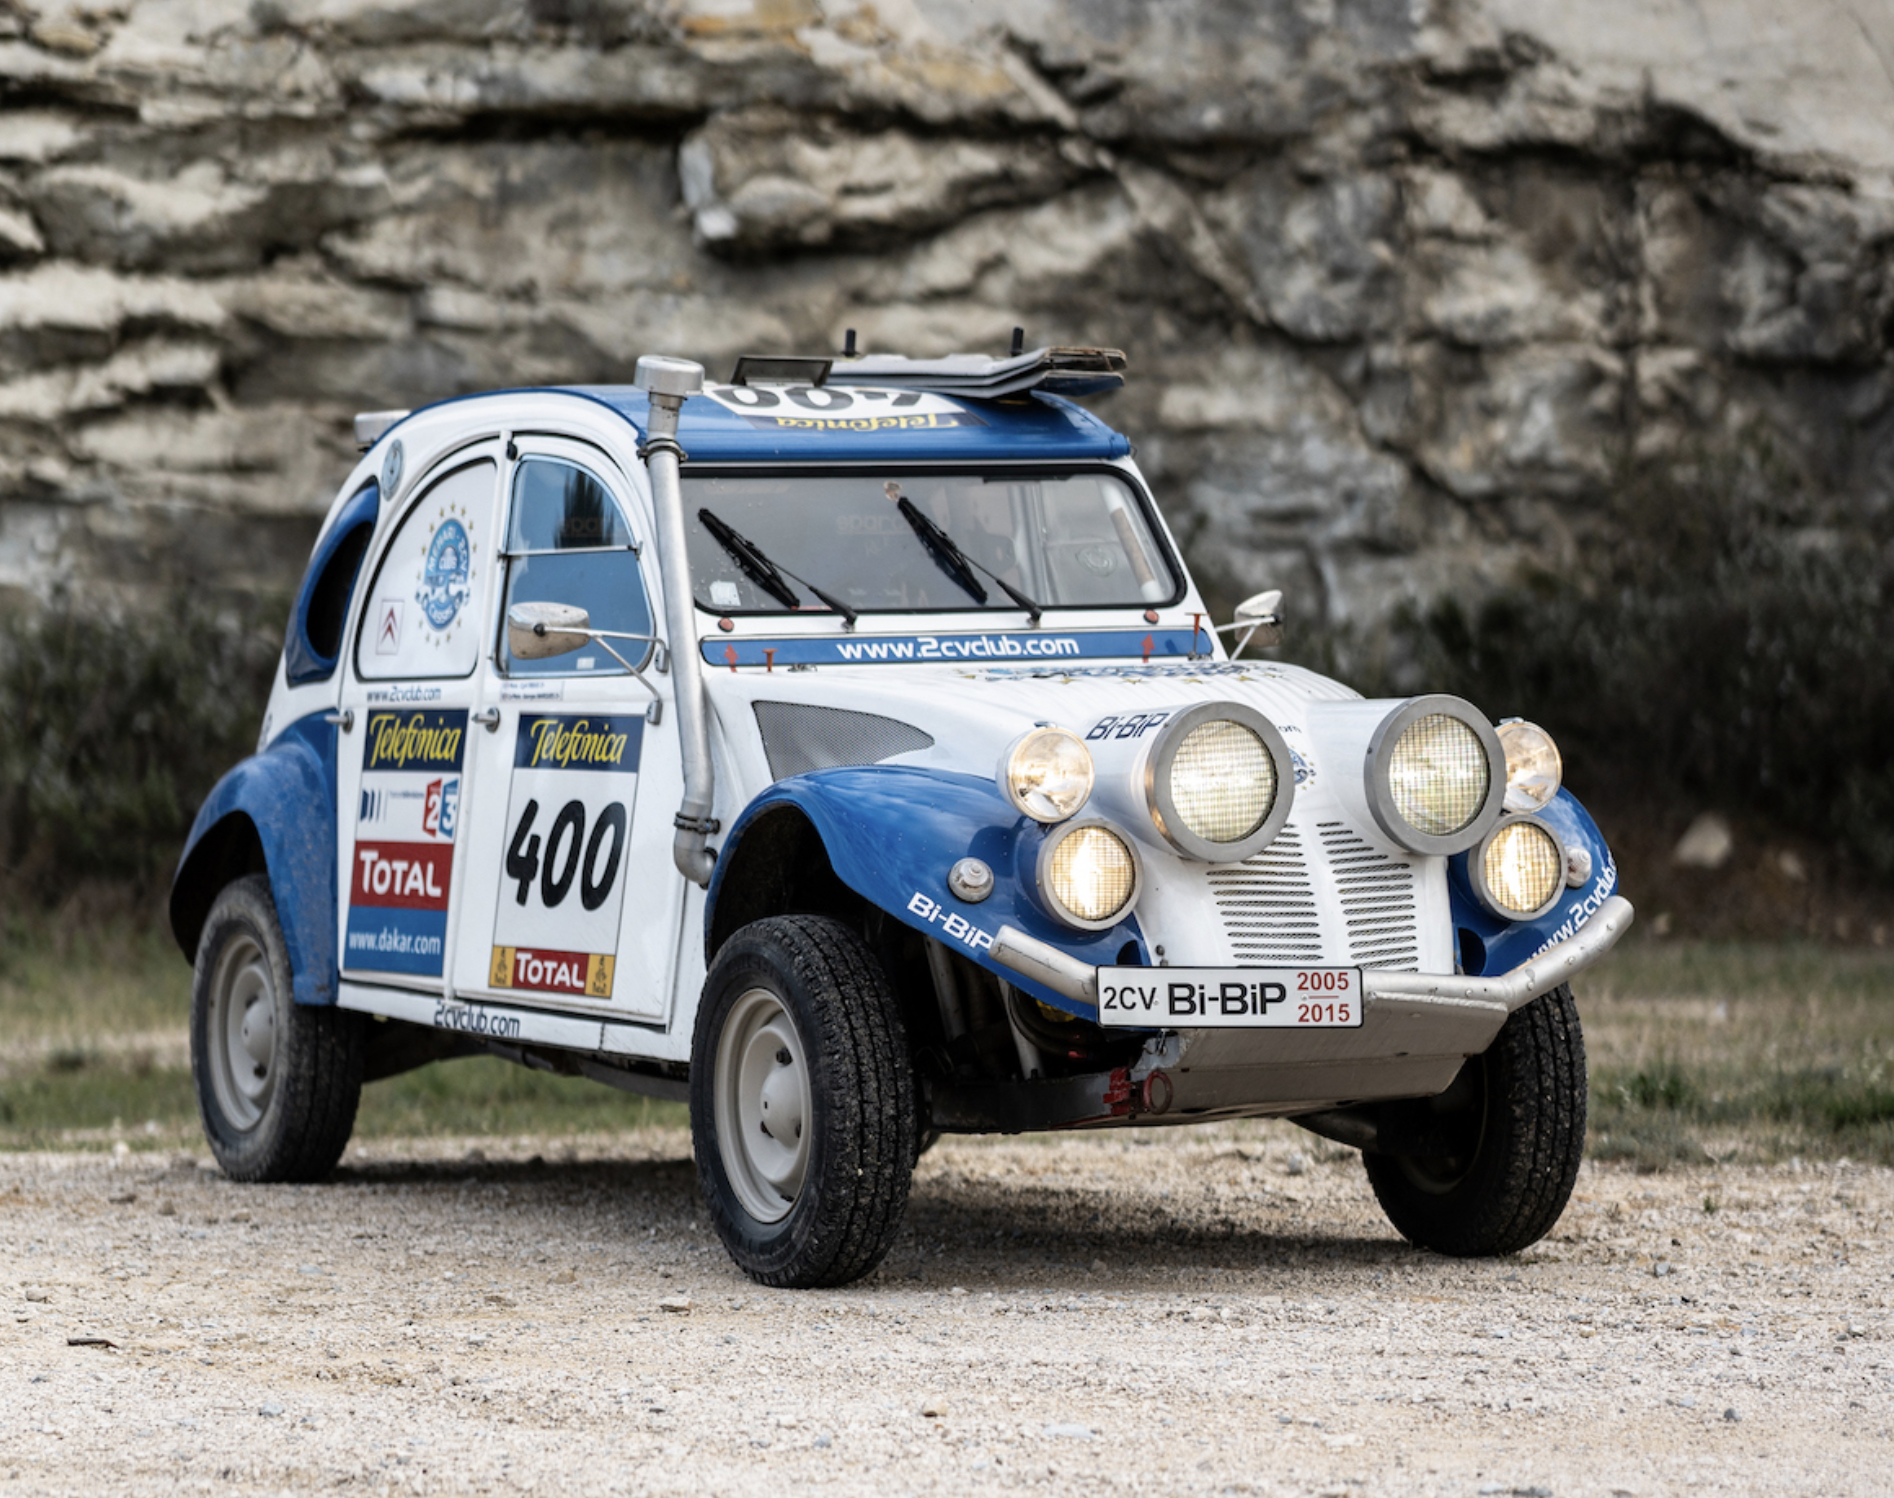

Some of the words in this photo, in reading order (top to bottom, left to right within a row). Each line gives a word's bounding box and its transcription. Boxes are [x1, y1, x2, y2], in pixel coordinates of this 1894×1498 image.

[836, 635, 1080, 660] www.2cvclub.com
[370, 713, 461, 768] Telefonica
[530, 719, 628, 768] Telefonica
[1084, 712, 1170, 740] Bi-BiP
[506, 797, 627, 911] 400
[360, 849, 442, 898] TOTAL
[907, 891, 995, 950] Bi-BiP
[348, 926, 441, 955] www.dakar.com
[516, 951, 585, 989] TOTAL
[1297, 972, 1349, 991] 2005
[434, 999, 520, 1038] 2cvclub.com
[1103, 986, 1158, 1010] 2CV
[1167, 983, 1287, 1016] Bi-BiP
[1298, 1003, 1350, 1023] 2015
